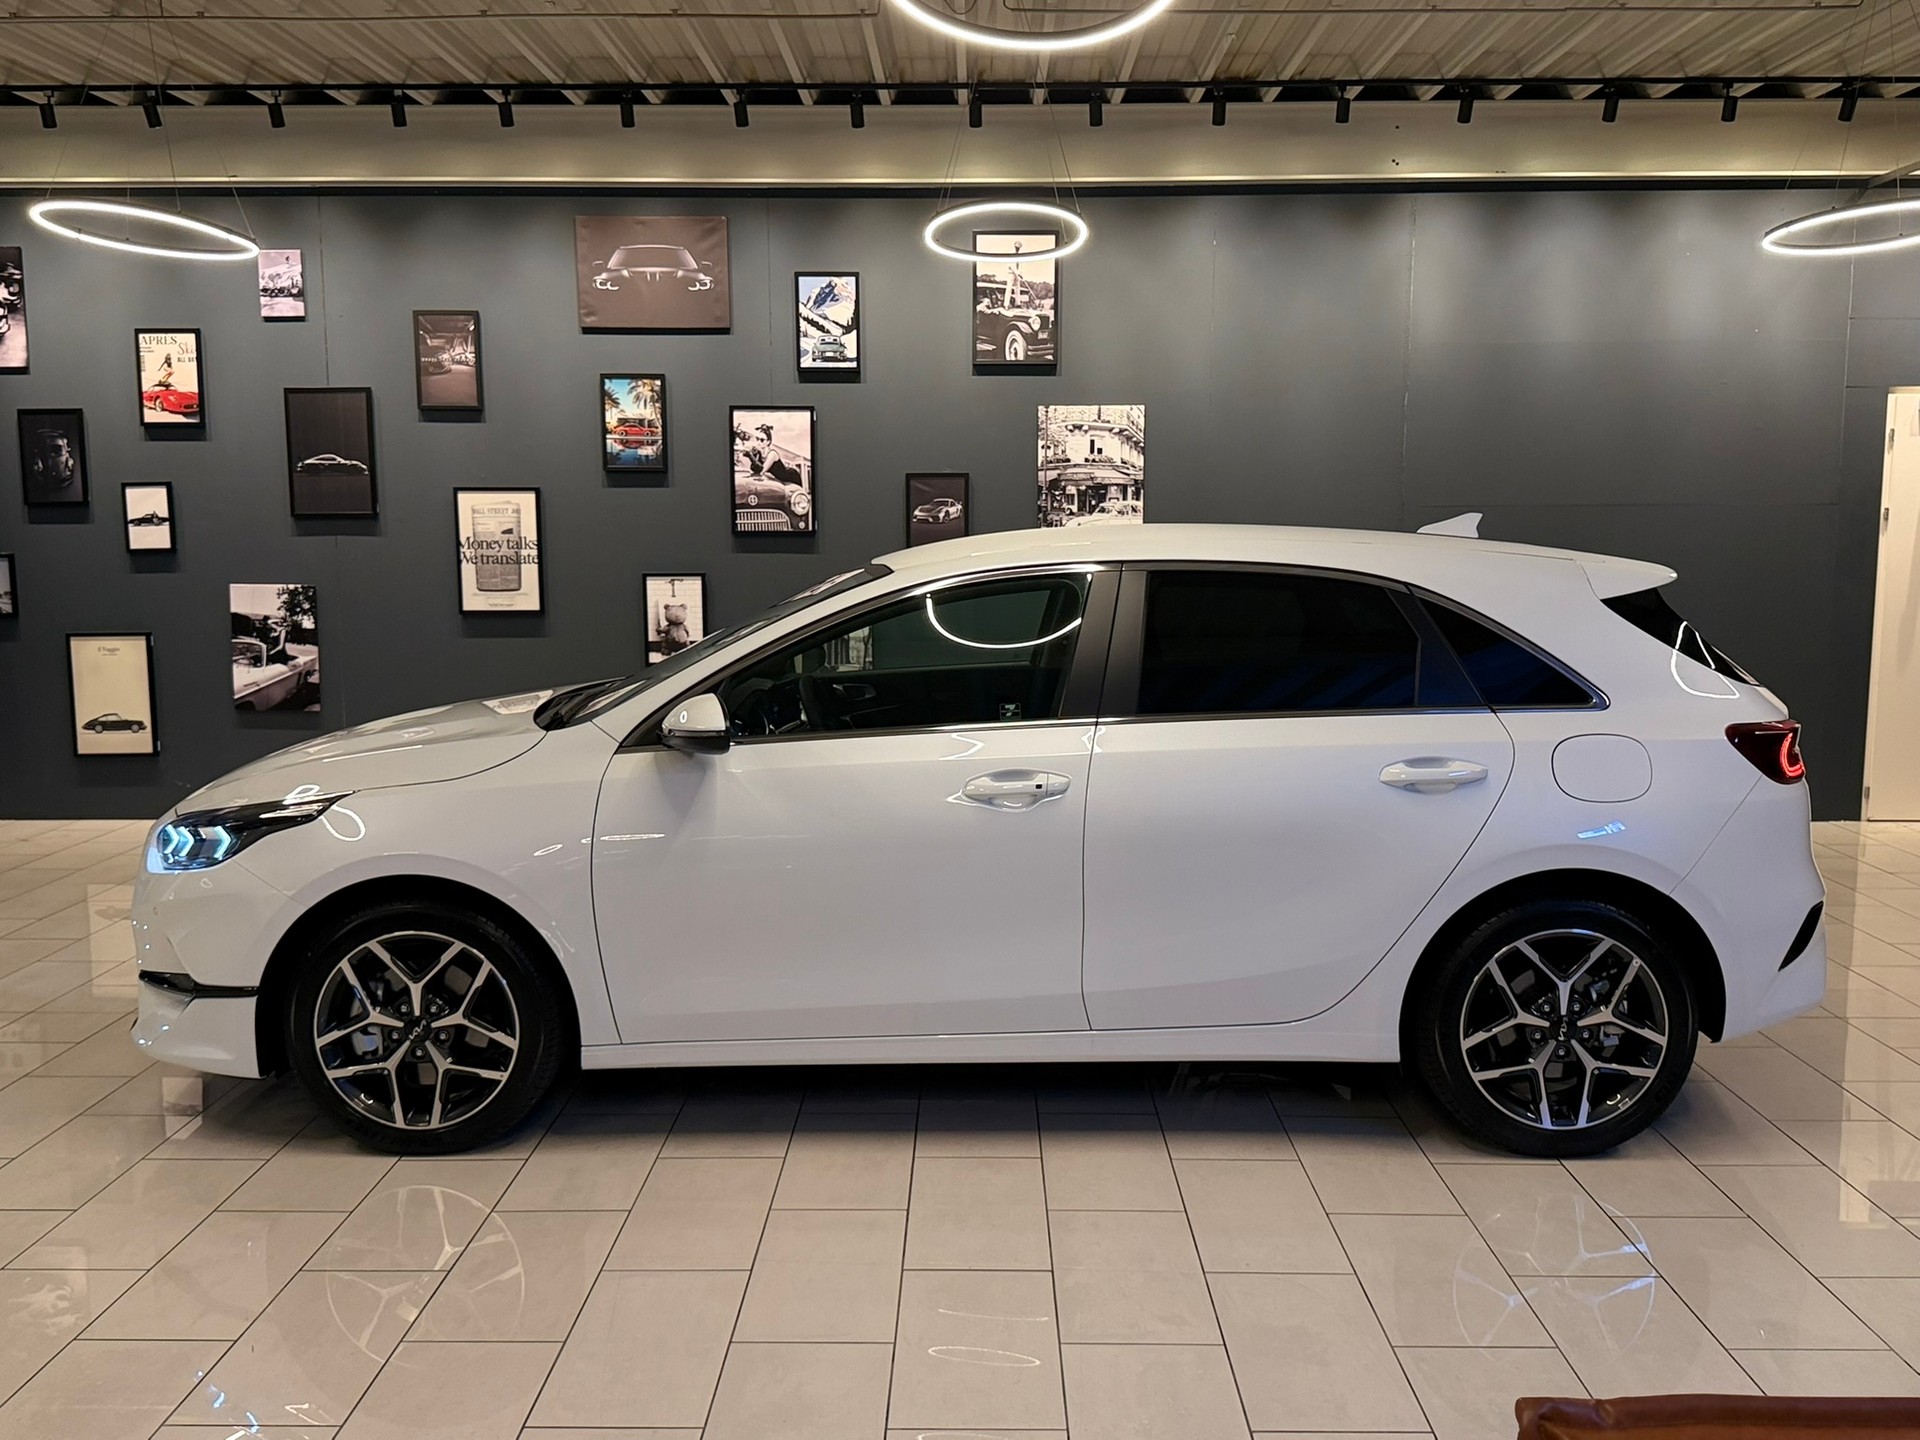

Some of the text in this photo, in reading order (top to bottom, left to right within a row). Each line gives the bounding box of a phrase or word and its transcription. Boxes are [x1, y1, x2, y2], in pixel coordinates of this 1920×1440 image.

[178, 342, 194, 355] Ski
[458, 536, 539, 552] Money talks
[480, 551, 540, 565] translate
